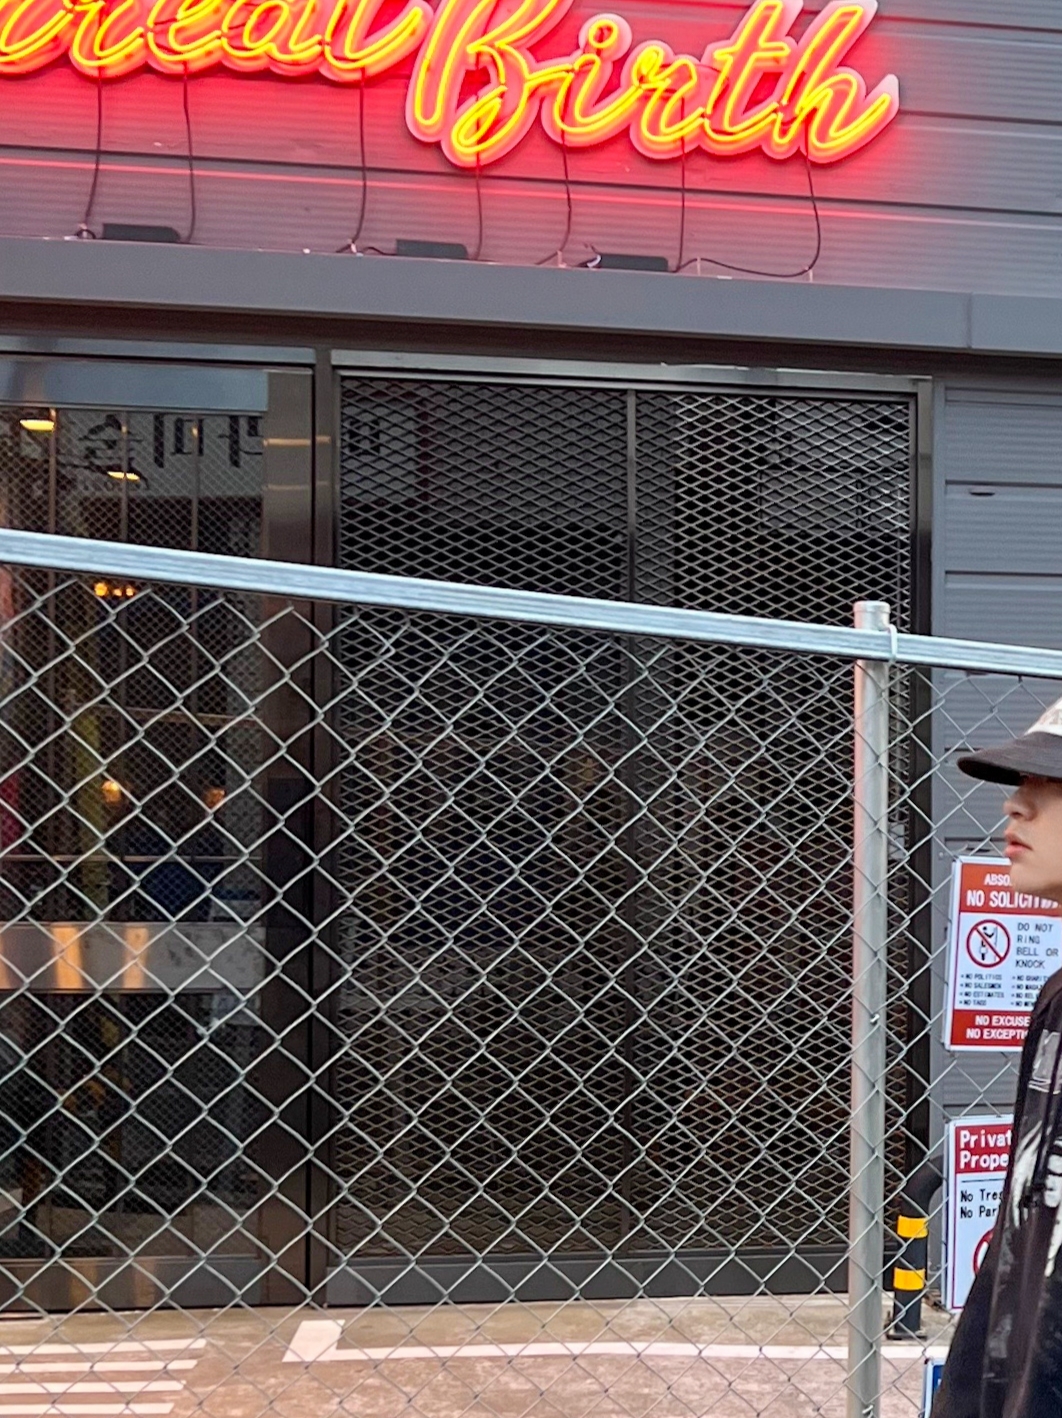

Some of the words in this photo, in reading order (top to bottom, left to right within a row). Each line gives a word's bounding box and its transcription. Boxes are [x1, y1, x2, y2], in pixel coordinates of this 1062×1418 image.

[408, 0, 898, 162] Birth
[984, 873, 1012, 886] ABSO
[966, 889, 985, 907] NO
[1017, 922, 1030, 932] DO
[1035, 923, 1054, 933] NOT
[1016, 934, 1040, 944] RING
[1015, 947, 1039, 957] BELL
[1045, 948, 1059, 957] OR
[1015, 959, 1046, 969] KNOCK
[975, 1015, 989, 1026] NO
[966, 1028, 981, 1039] NO
[960, 1189, 974, 1202] No
[960, 1206, 973, 1219] No
